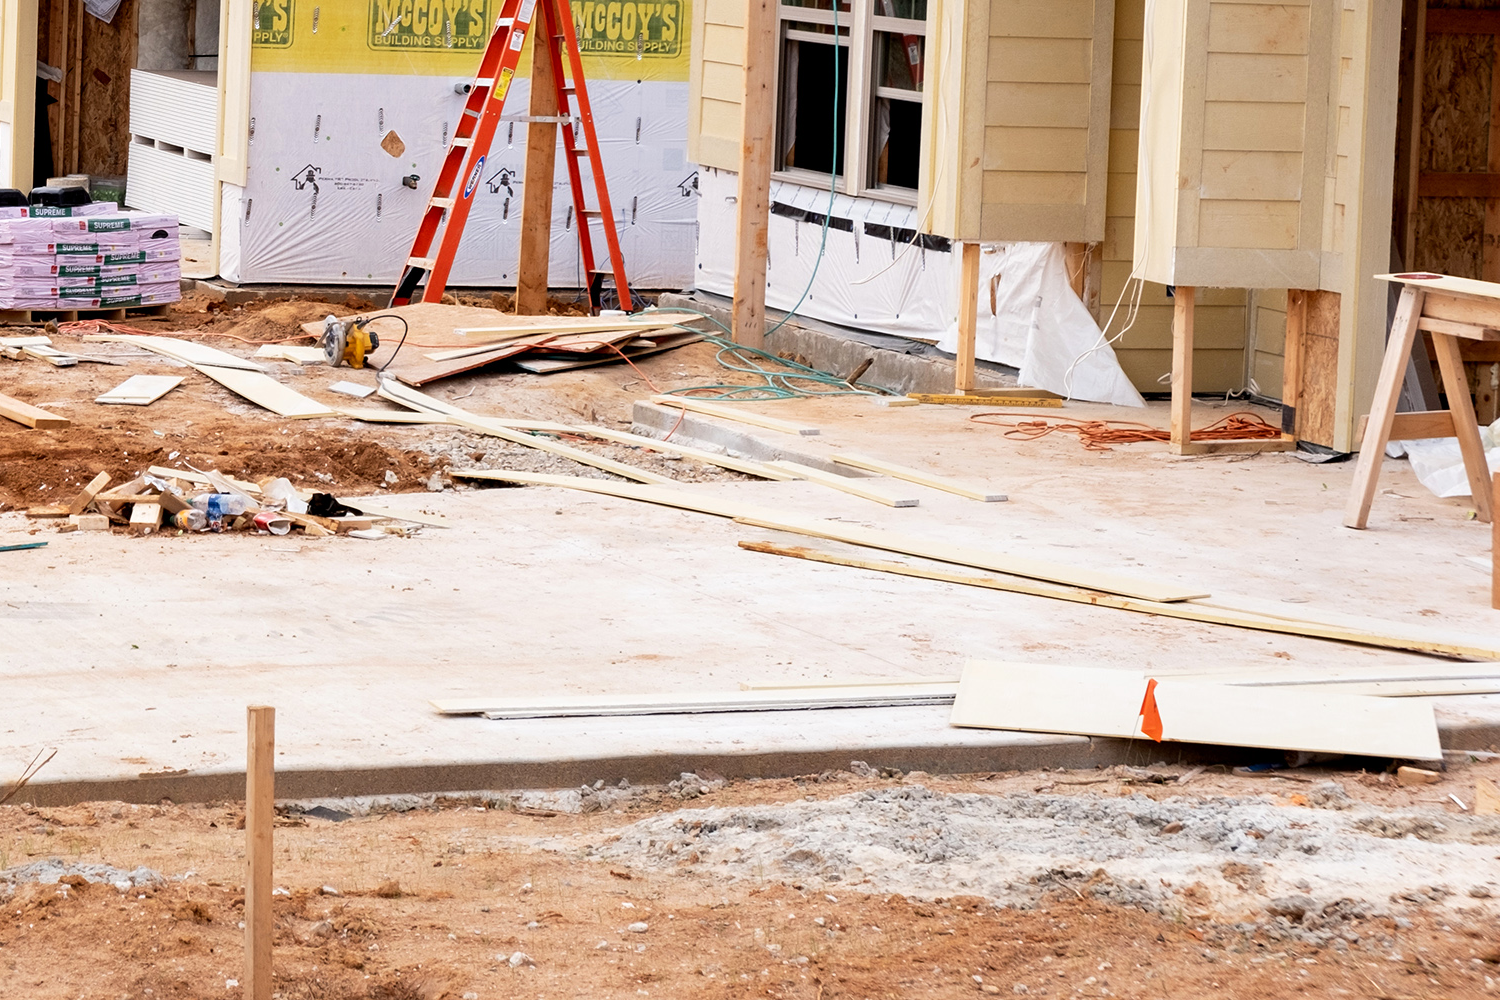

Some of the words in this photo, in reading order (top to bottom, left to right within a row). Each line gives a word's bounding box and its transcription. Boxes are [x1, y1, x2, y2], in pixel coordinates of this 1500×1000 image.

[375, 35, 431, 47] BUILDING
[467, 163, 482, 190] WERNER
[35, 208, 66, 216] SUPREME
[94, 221, 125, 229] SUPREME
[62, 244, 93, 252] SUPREME
[111, 252, 140, 260] SUPREME
